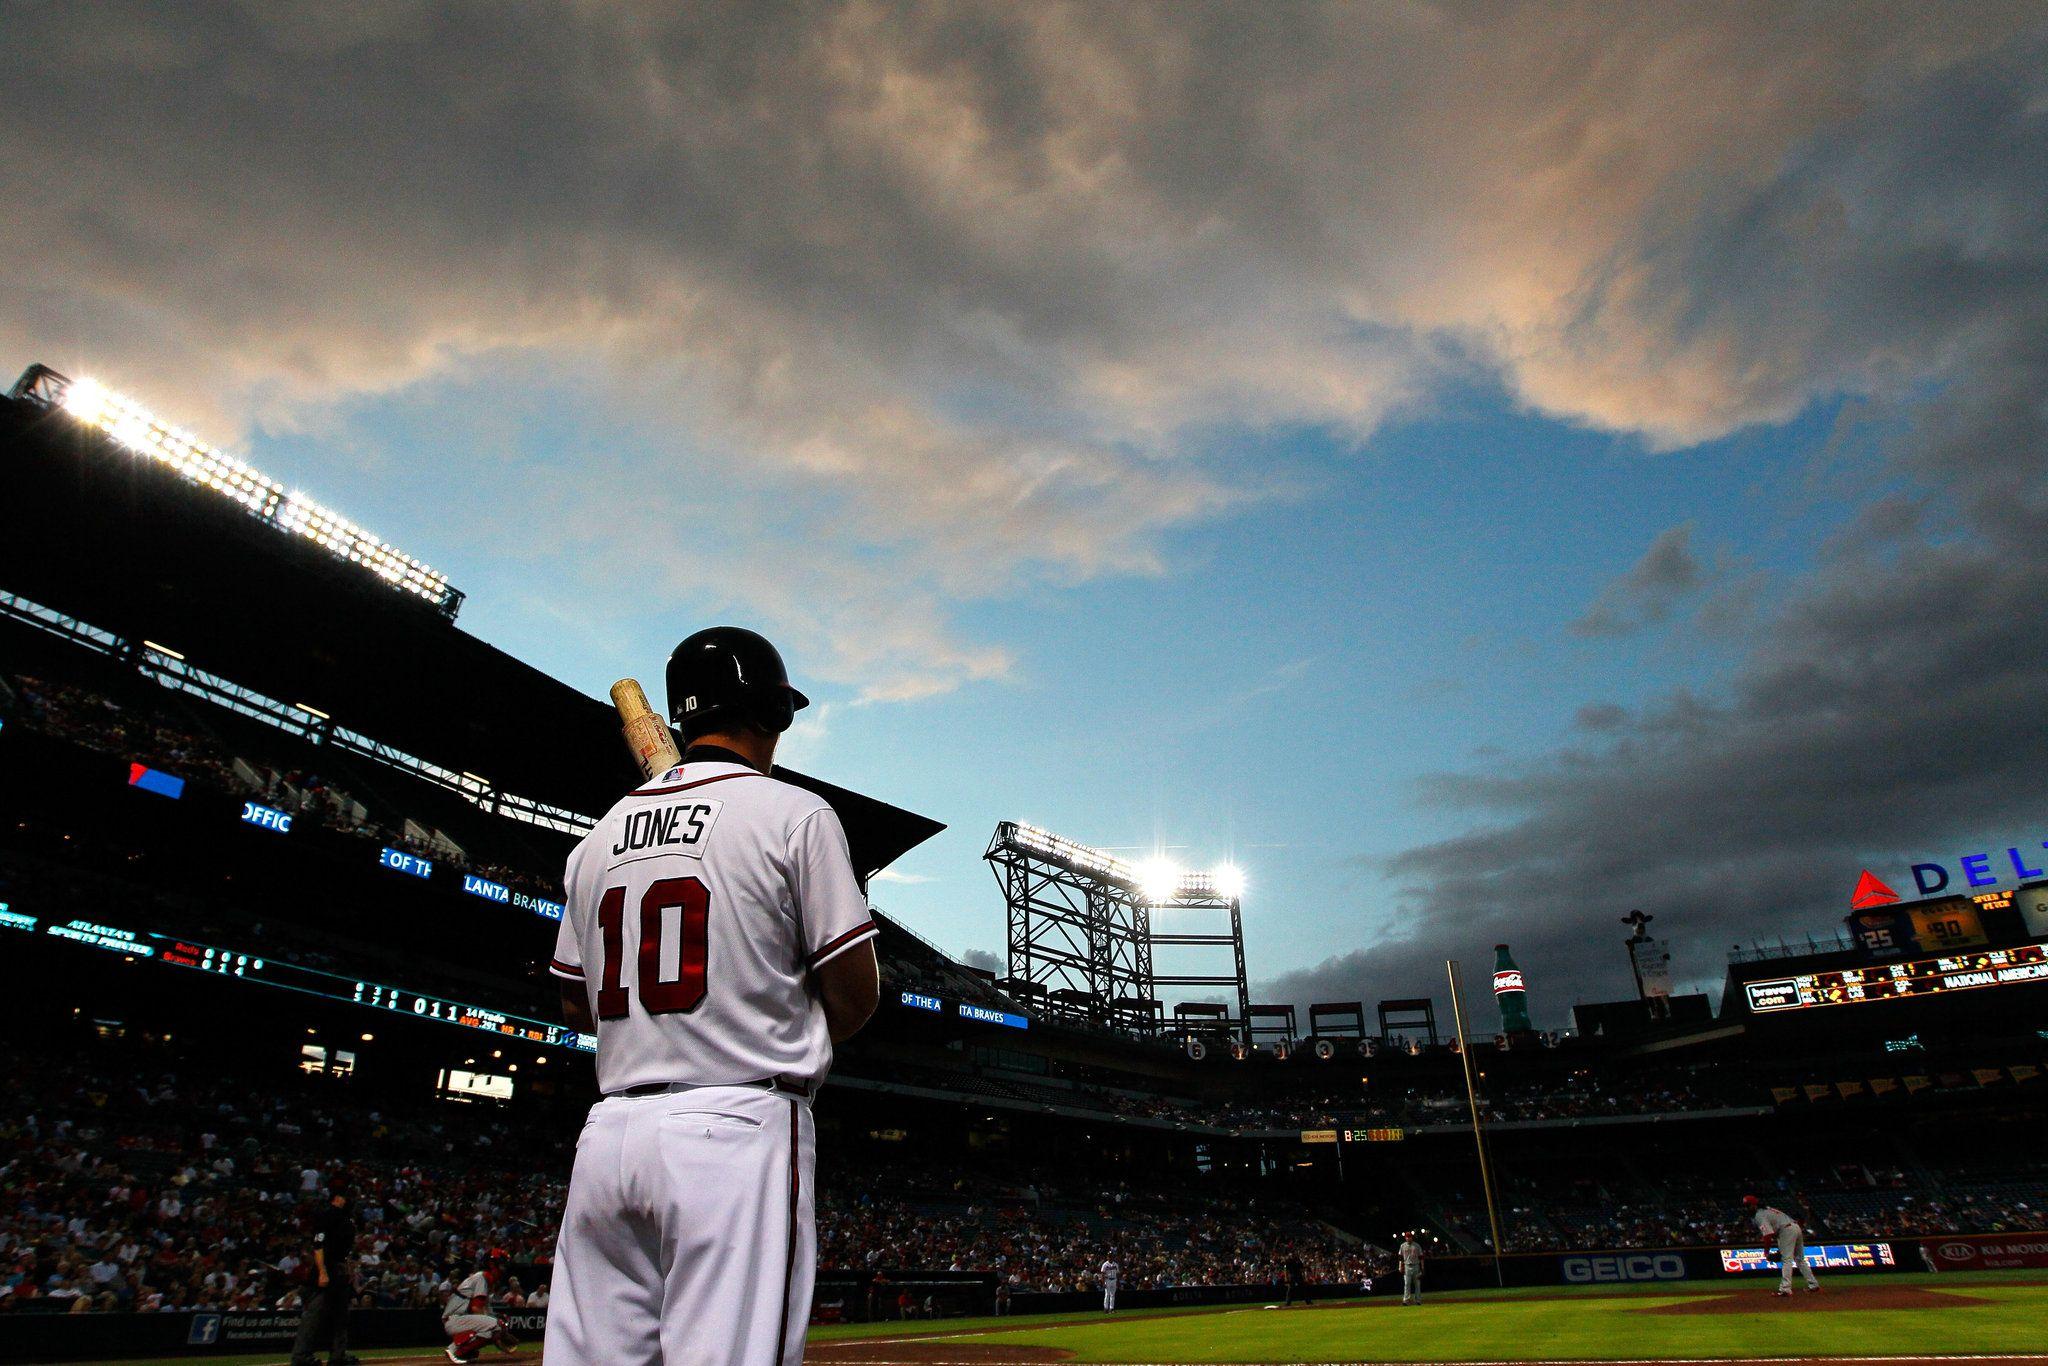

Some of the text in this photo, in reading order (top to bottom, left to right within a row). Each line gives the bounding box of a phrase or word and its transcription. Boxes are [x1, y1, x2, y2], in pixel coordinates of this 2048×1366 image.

[685, 695, 698, 712] 10
[241, 803, 292, 832] OFFIC
[612, 804, 711, 857] JONES
[389, 852, 412, 870] OF
[1911, 841, 2048, 896] DEL
[464, 875, 560, 919] LANTA BRAVES
[1859, 929, 1894, 949] $25
[598, 875, 711, 1021] 10
[1943, 971, 1997, 989] NATIONAL
[1997, 965, 2048, 982] AMERICAN
[218, 962, 227, 974] 1
[234, 966, 244, 977] 4
[353, 992, 362, 1002] 5
[371, 996, 381, 1006] 7
[388, 1000, 397, 1009] 0
[373, 986, 382, 996] 3
[390, 990, 399, 1000] 0
[1752, 986, 1794, 998] braves
[414, 998, 427, 1014] 0
[901, 993, 942, 1010] OF THE A
[1755, 995, 1786, 1006] .com
[429, 1002, 441, 1018] 1
[447, 1006, 457, 1021] 1
[466, 1007, 506, 1024] 14 Prado
[974, 1008, 1004, 1023] BRAVES
[458, 1016, 544, 1041] AVG .291 HR 2 RBI
[547, 1026, 558, 1035] LF
[545, 1034, 557, 1044] 19
[1735, 1250, 1765, 1259] Johnny
[1944, 1246, 1970, 1257] KIA
[1980, 1244, 2048, 1256] KIA MOTO
[1563, 1255, 1685, 1282] GEICO
[1828, 1257, 1849, 1266] MPH
[222, 1315, 300, 1327] Find us on Faceb
